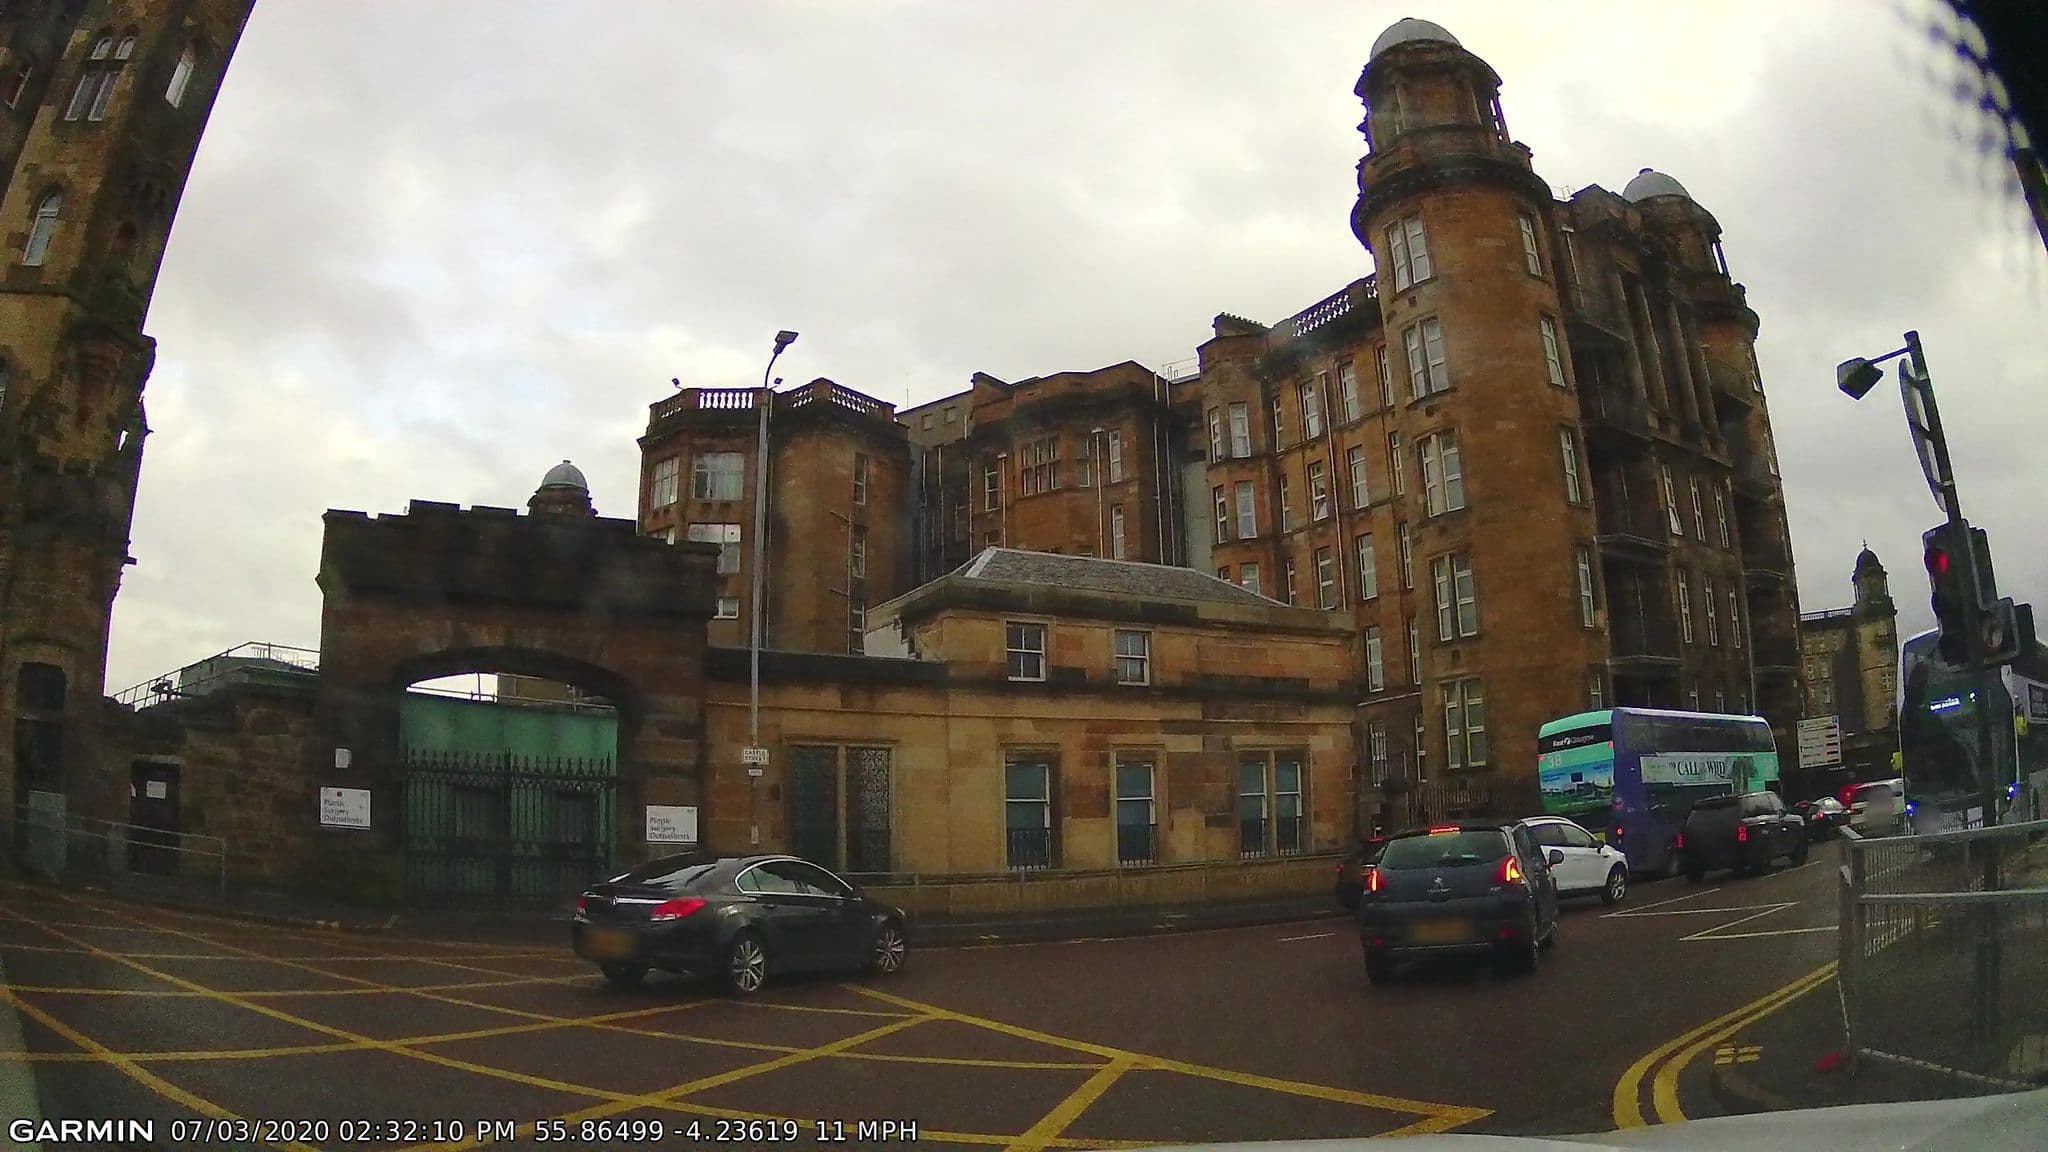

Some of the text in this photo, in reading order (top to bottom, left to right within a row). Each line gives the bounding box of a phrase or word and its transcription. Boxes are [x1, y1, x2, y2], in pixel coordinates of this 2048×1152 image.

[1677, 761, 1700, 776] CALL
[324, 807, 349, 815] Surgery
[650, 825, 676, 833] Surgery
